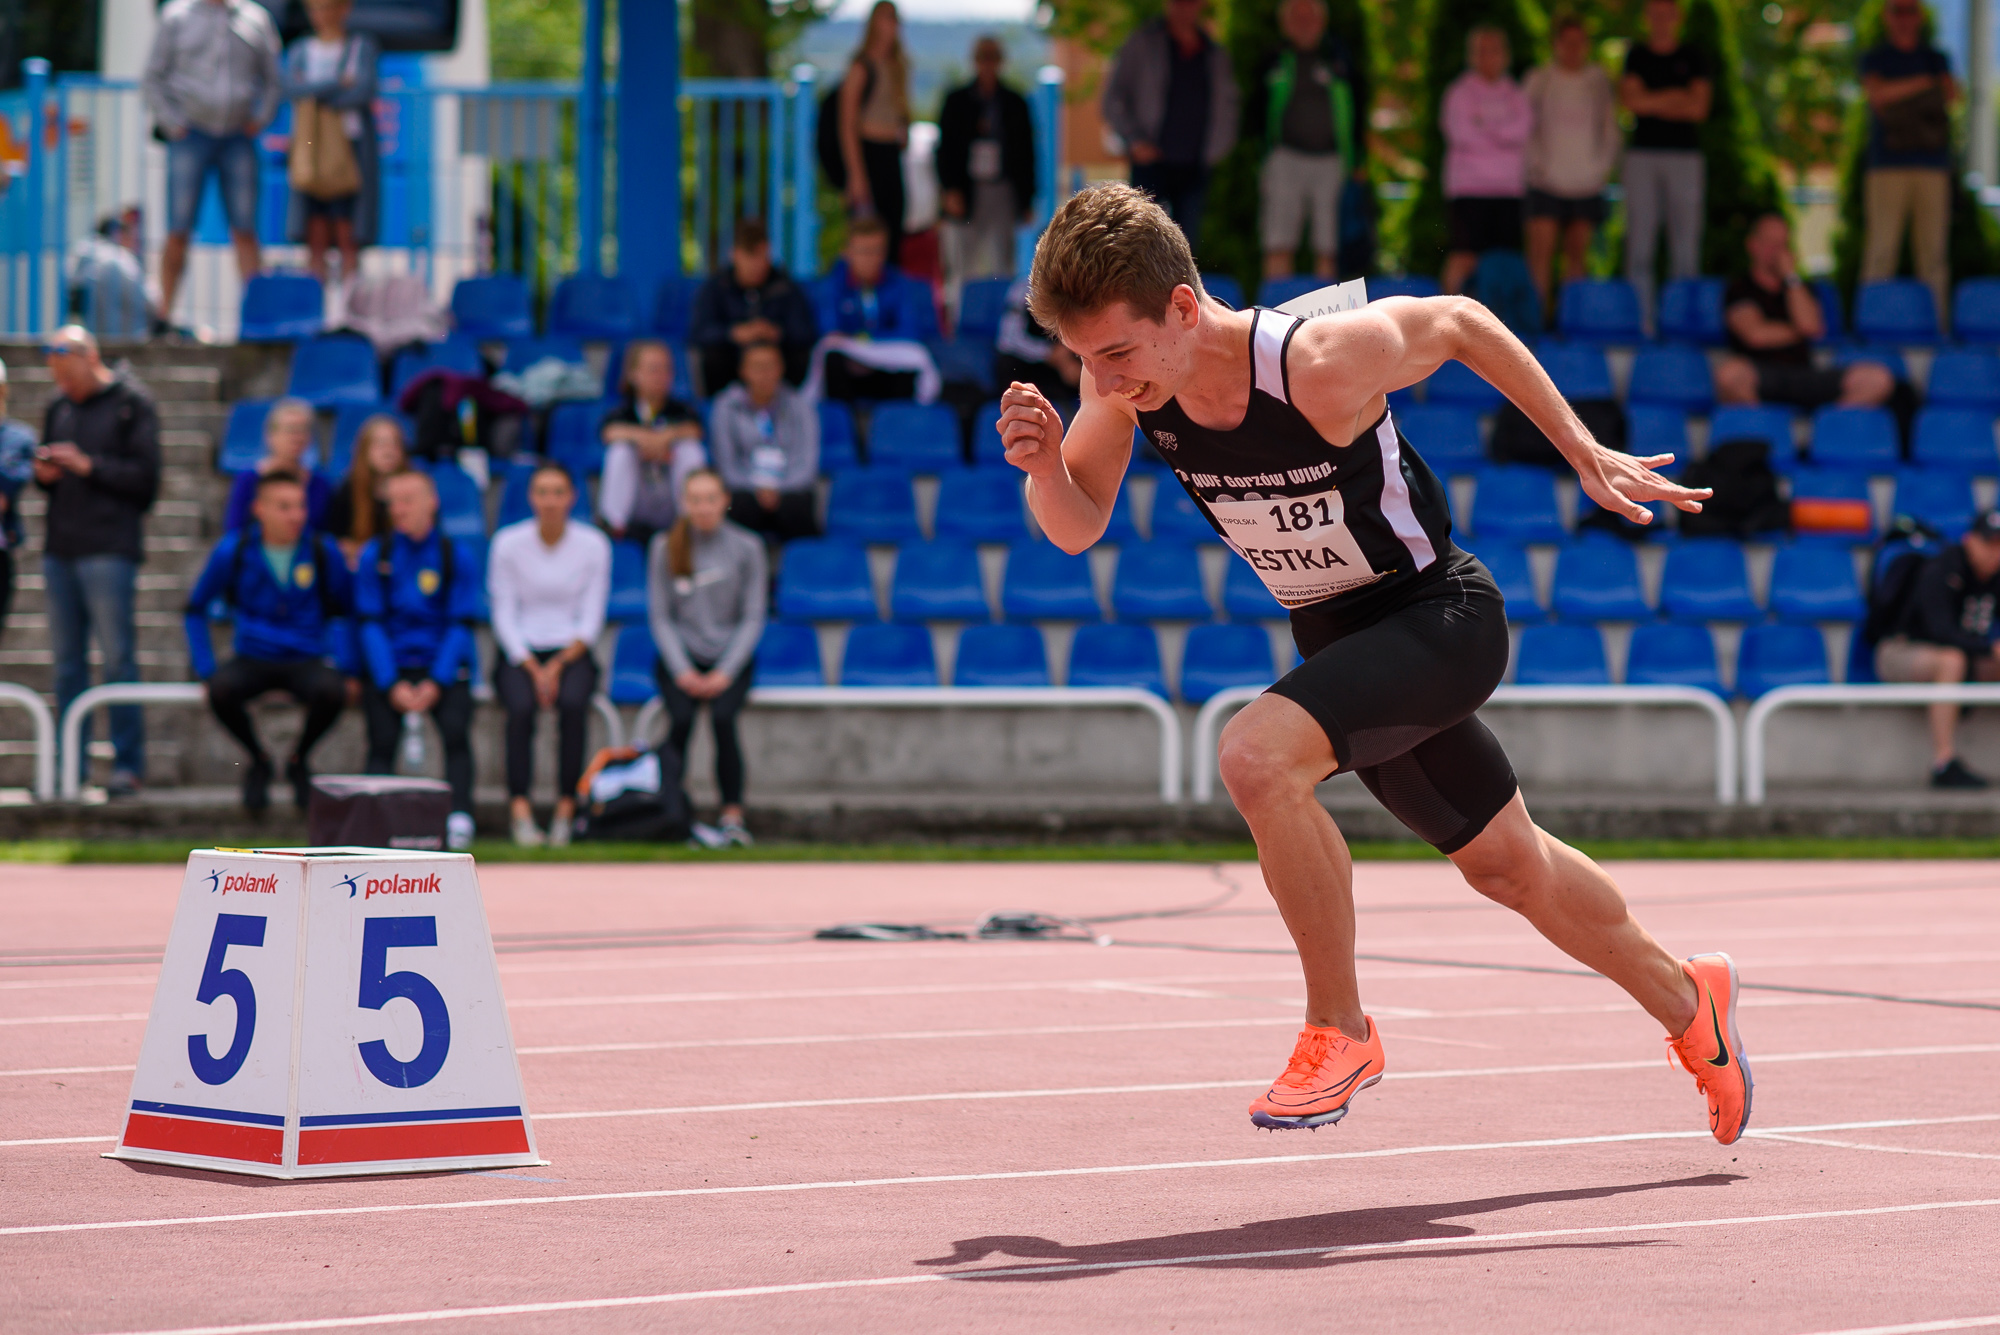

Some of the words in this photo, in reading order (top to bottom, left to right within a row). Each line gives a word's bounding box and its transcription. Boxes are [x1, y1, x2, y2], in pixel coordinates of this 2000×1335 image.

[1223, 472, 1286, 488] Gorzów
[1269, 497, 1335, 533] 181
[222, 873, 279, 896] polanik
[365, 872, 442, 900] polanik
[188, 913, 268, 1086] 5
[357, 916, 451, 1089] 5
